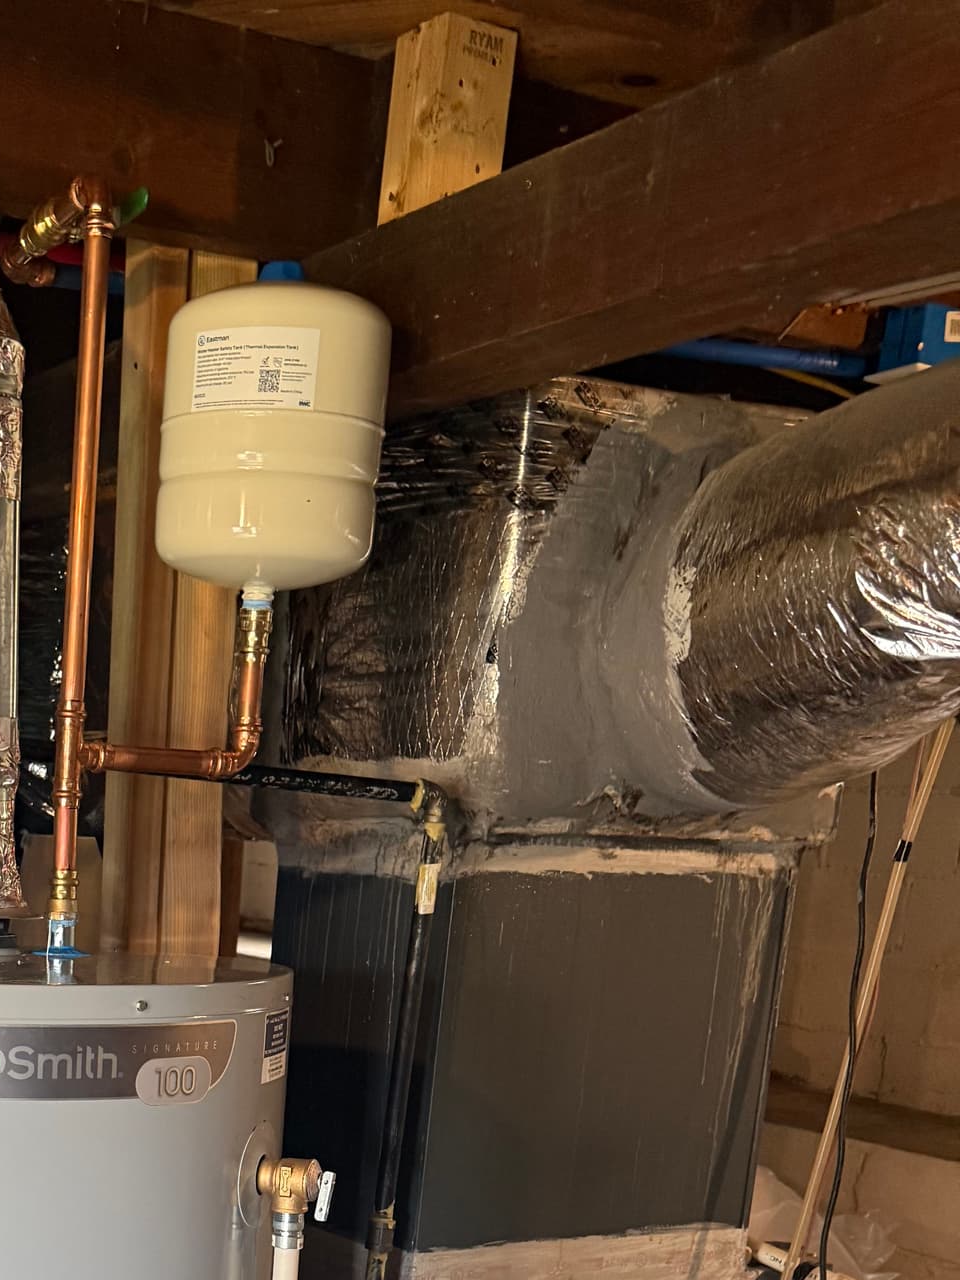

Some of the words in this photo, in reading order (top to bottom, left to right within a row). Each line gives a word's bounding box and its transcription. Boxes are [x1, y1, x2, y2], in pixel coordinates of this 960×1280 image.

[207, 335, 229, 343] Eastman
[132, 1040, 219, 1055] SIGNATURE
[155, 1066, 196, 1097] 100
